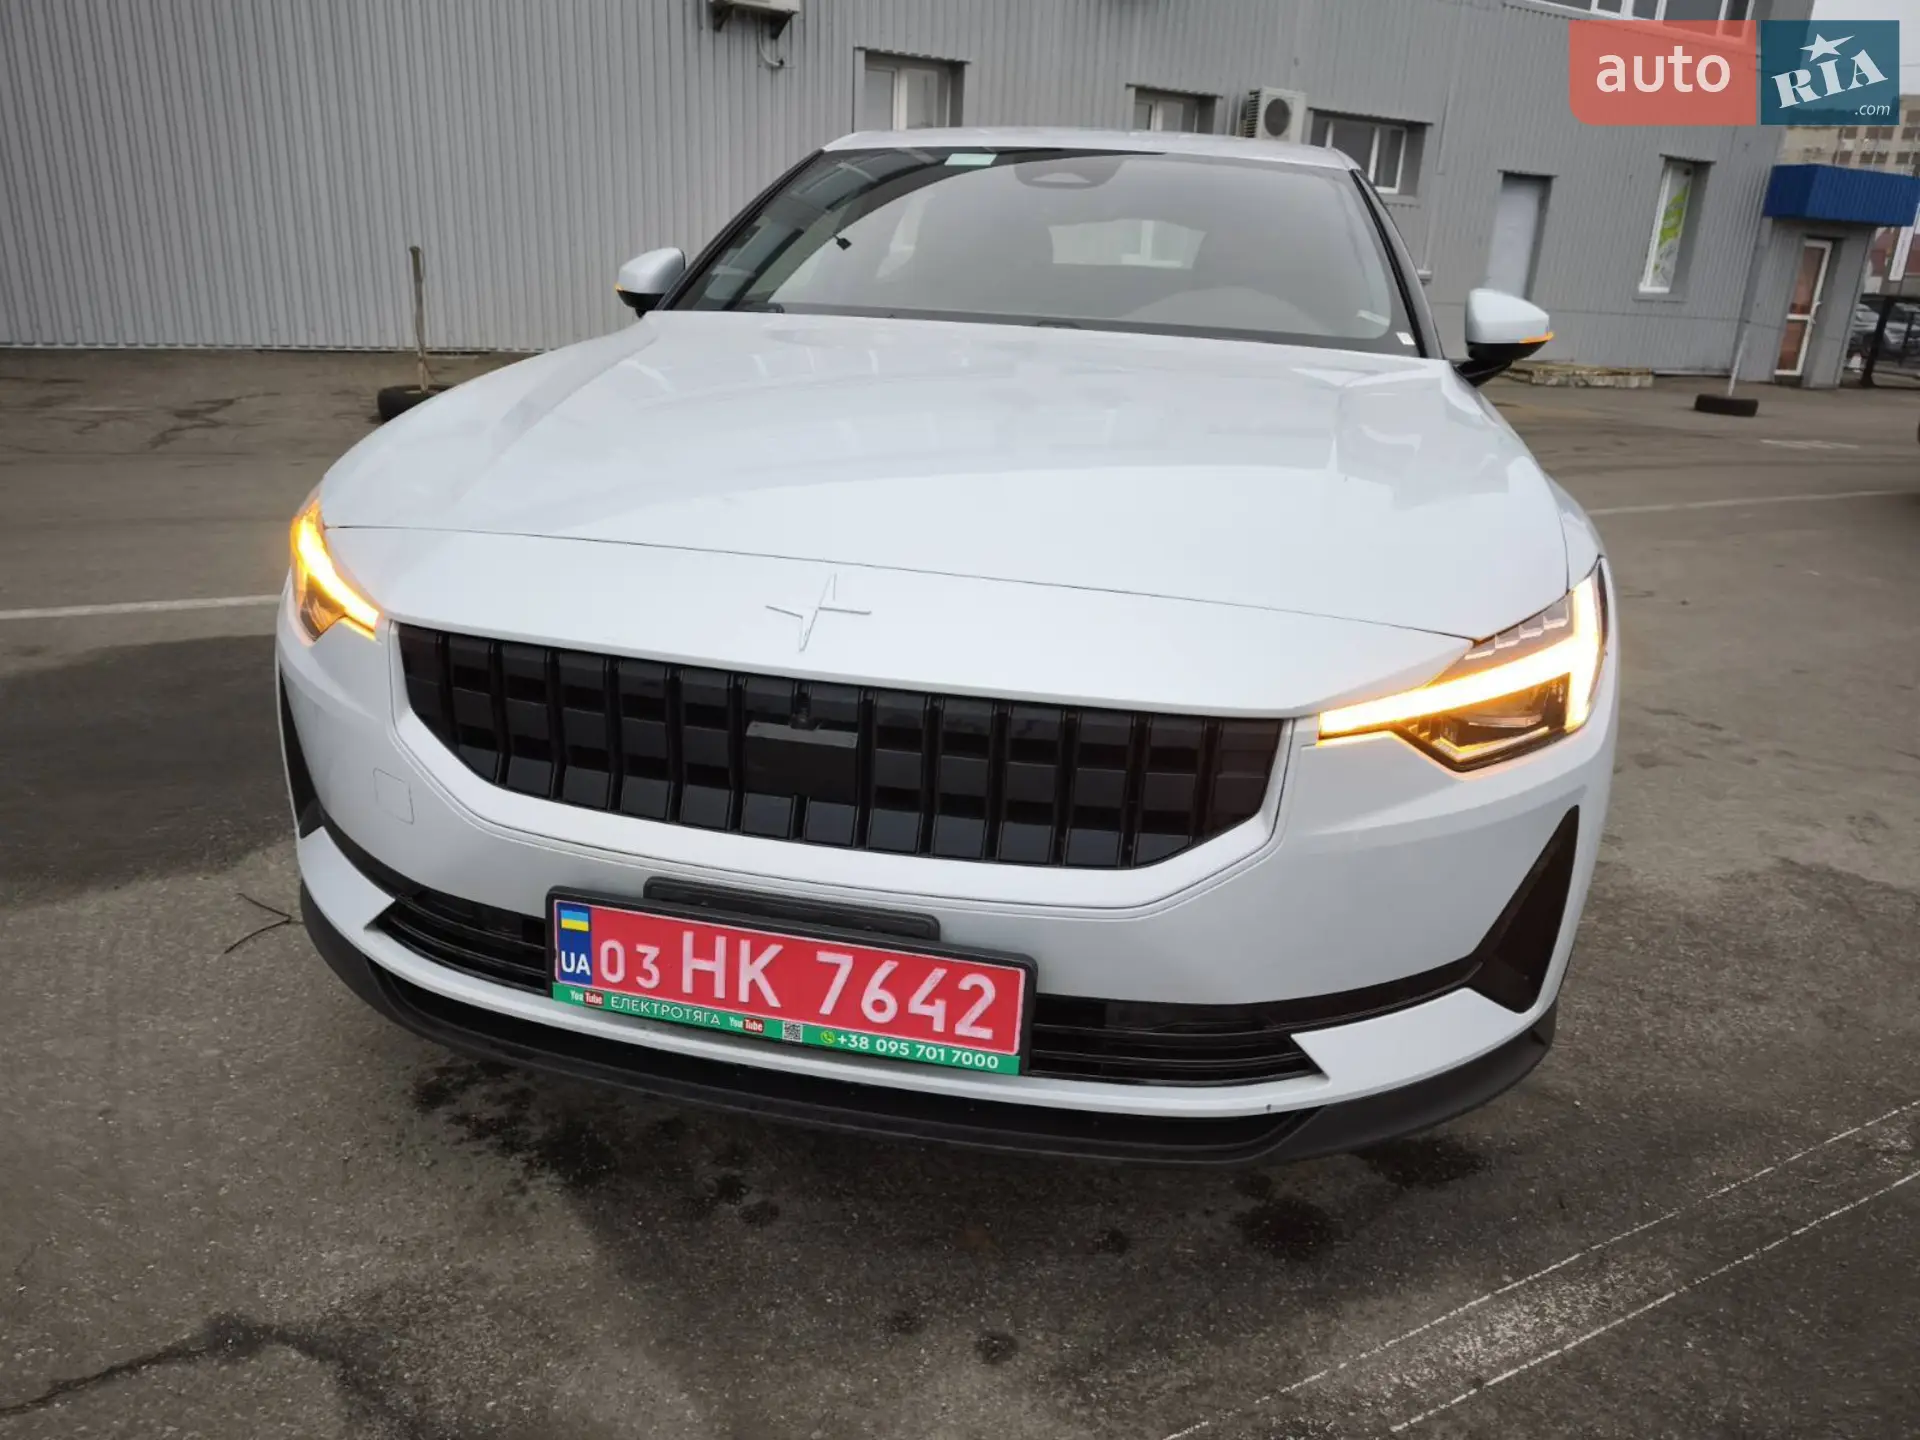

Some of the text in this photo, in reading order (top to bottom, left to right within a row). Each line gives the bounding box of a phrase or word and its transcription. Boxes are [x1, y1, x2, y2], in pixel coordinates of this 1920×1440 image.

[561, 951, 591, 976] UA
[600, 930, 996, 1041] 03 HK 7642
[611, 996, 721, 1026] ЕЛЕКТРОТЯГА
[837, 1034, 999, 1069] +38 095 701 7000
